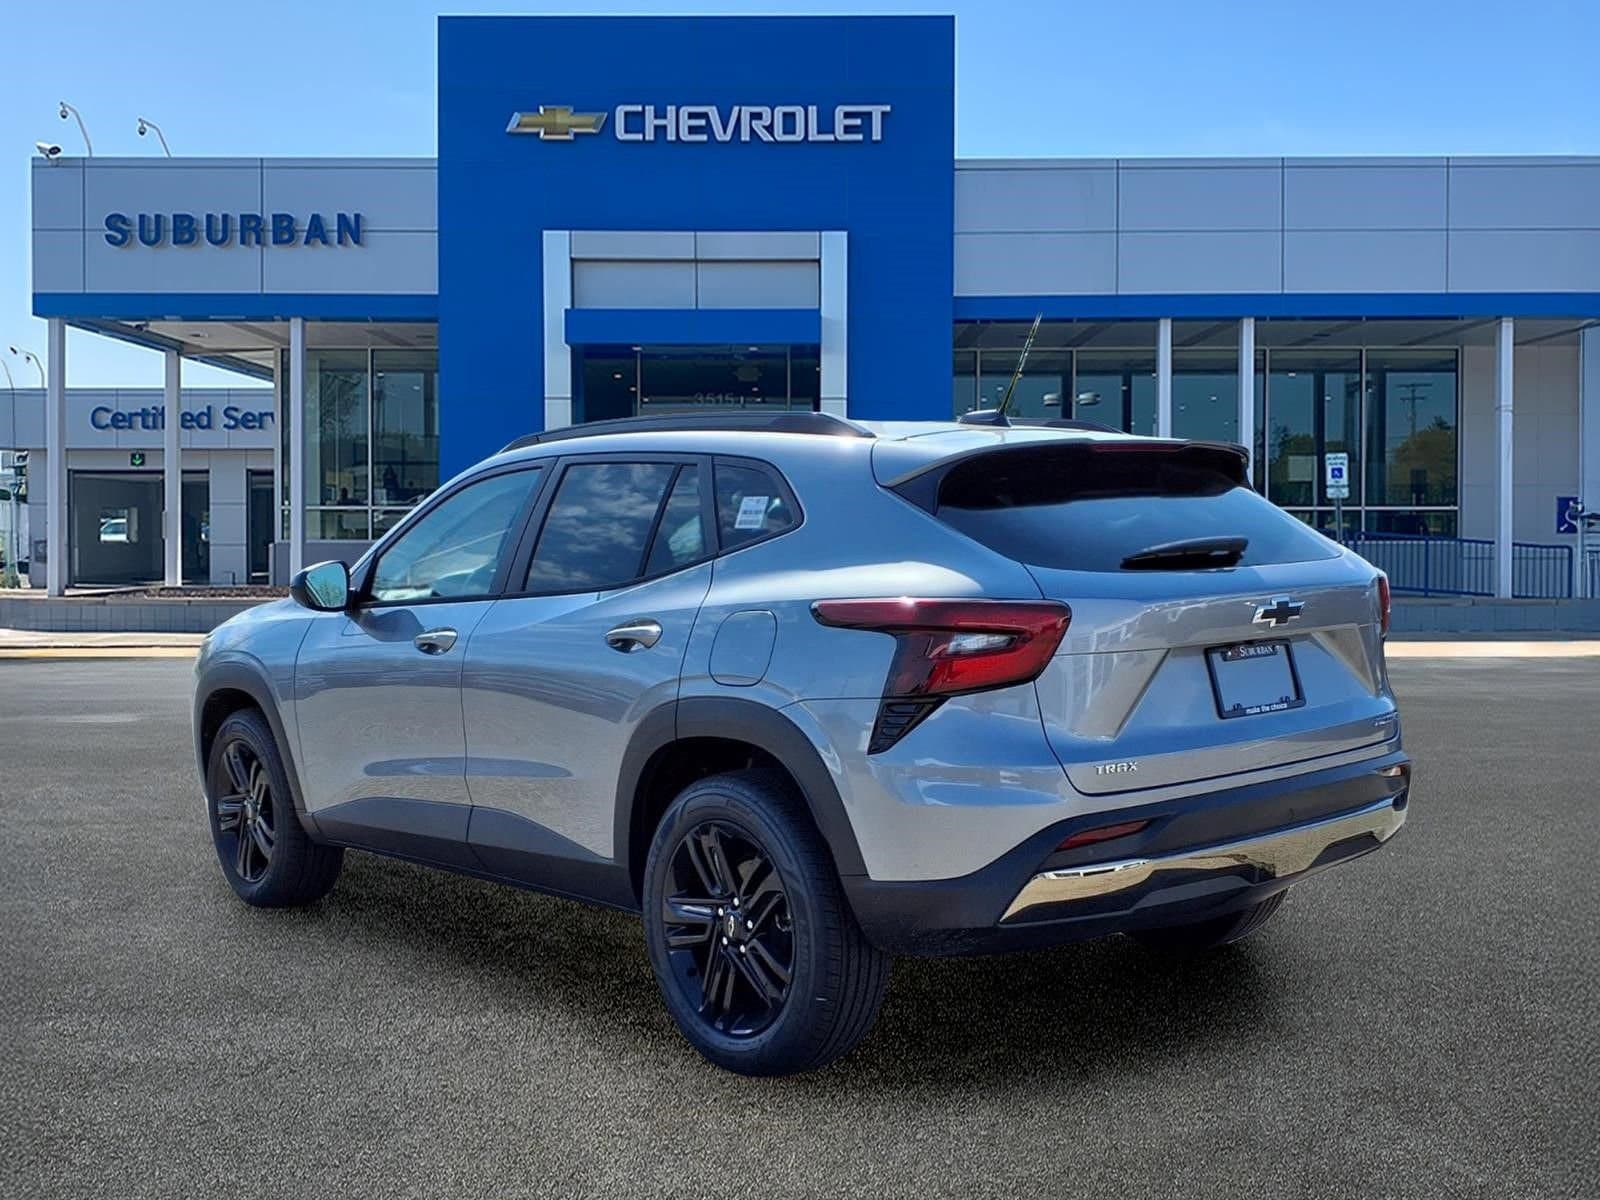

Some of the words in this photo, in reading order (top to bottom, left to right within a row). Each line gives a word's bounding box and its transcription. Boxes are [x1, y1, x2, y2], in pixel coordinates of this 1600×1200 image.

[615, 105, 892, 142] CHEVROLET
[104, 213, 363, 247] SUBURBAN
[90, 405, 213, 430] Certifed
[1094, 761, 1137, 775] TRAX
